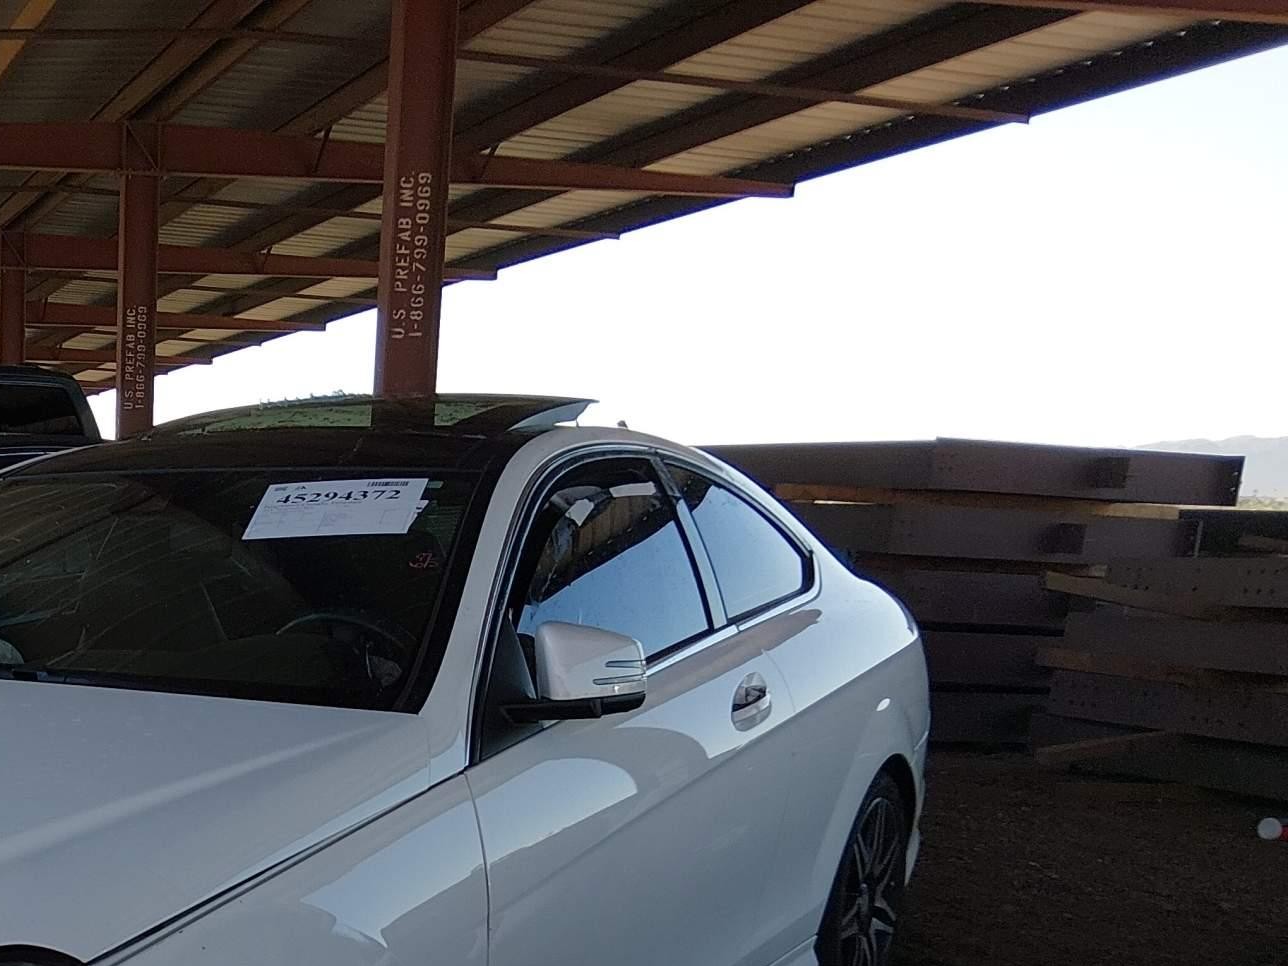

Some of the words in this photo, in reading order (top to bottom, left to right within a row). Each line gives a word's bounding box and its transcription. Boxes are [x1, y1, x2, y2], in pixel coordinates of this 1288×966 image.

[400, 171, 415, 207] INC.
[394, 218, 412, 292] PREFAB
[409, 172, 432, 337] 1-866-799-0969
[125, 334, 135, 381] PREFAB
[276, 489, 401, 504] 45294372
